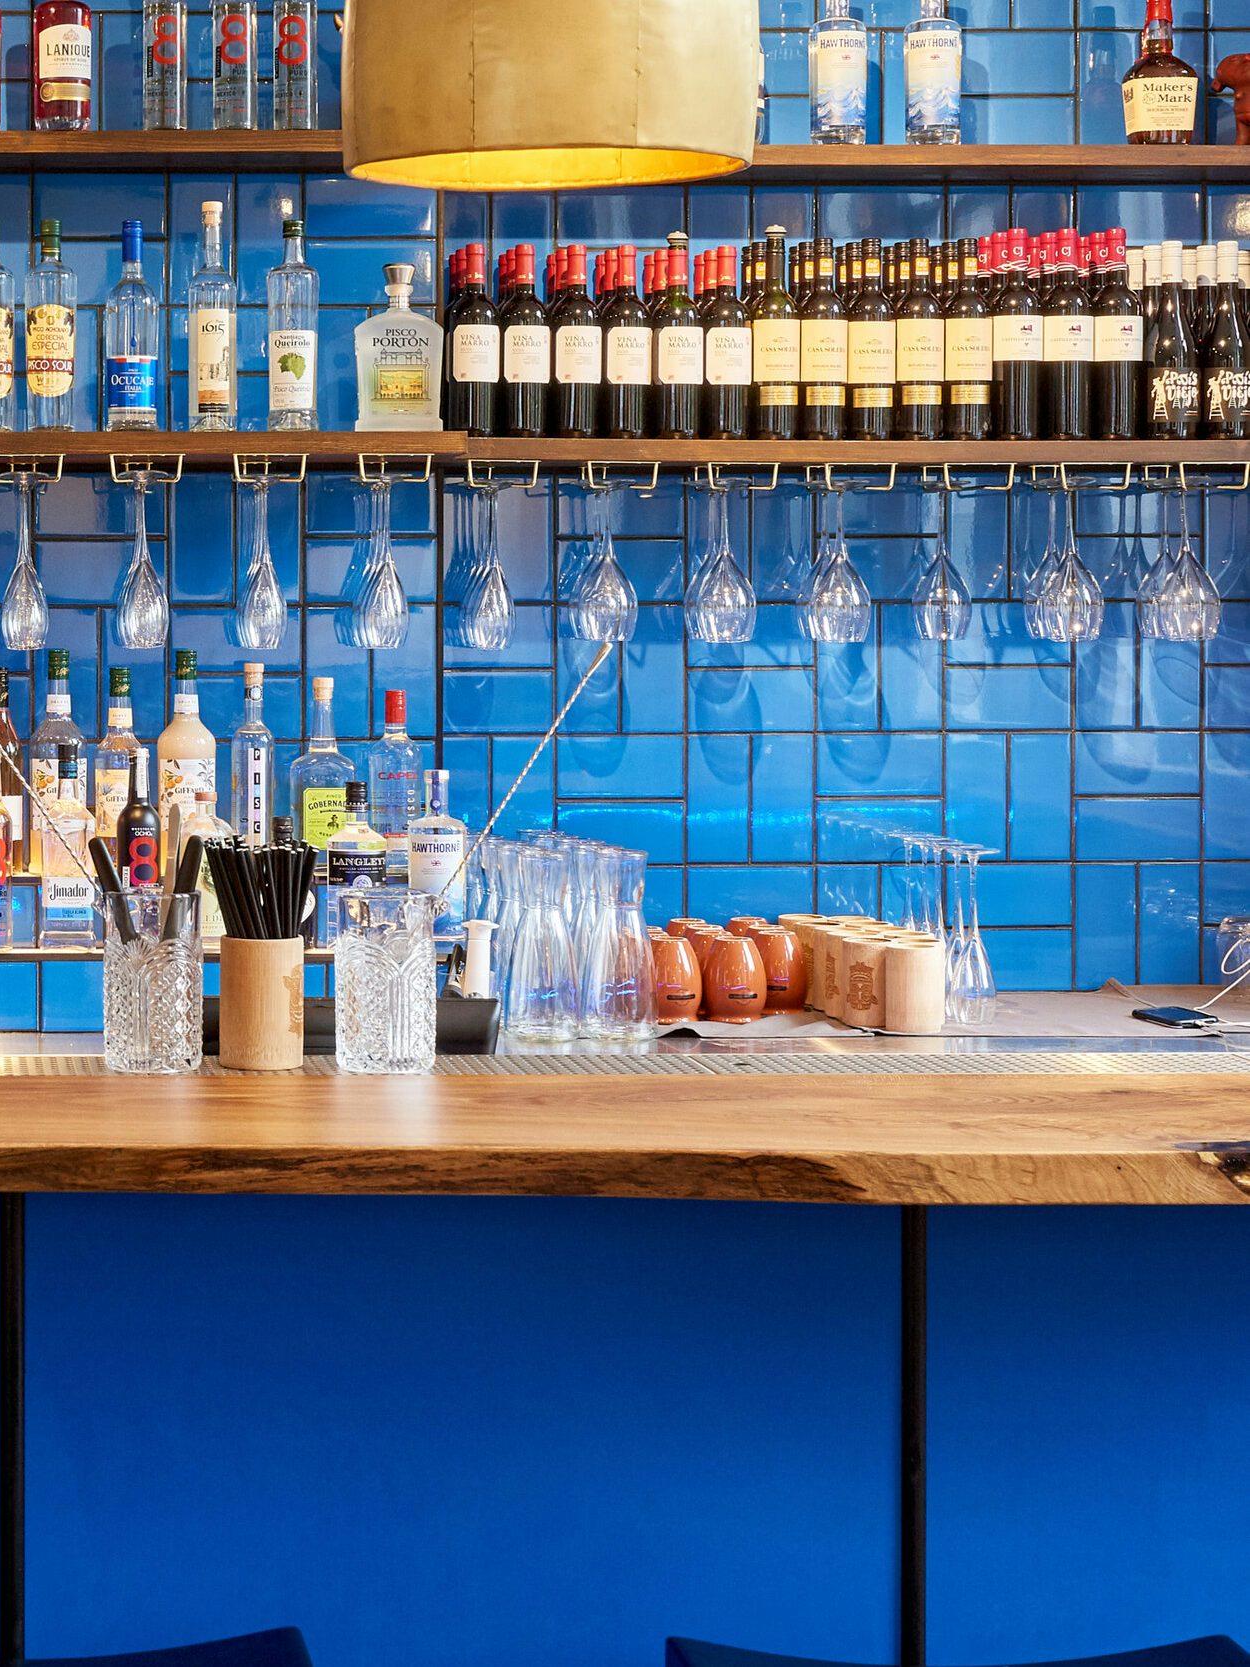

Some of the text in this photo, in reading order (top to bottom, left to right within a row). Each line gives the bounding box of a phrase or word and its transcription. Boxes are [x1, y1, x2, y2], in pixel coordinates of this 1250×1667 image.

[154, 15, 182, 64] 8
[221, 15, 249, 64] 8
[279, 15, 307, 64] 8
[46, 44, 90, 57] LANIQUE
[1143, 83, 1193, 91] Maker's
[1158, 94, 1192, 102] Mark
[385, 329, 417, 337] PISCO
[32, 342, 68, 351] ESPECIAL
[275, 339, 310, 348] Queirolo
[52, 361, 72, 371] SOUR
[129, 836, 159, 886] 8
[50, 883, 89, 900] Jimador
